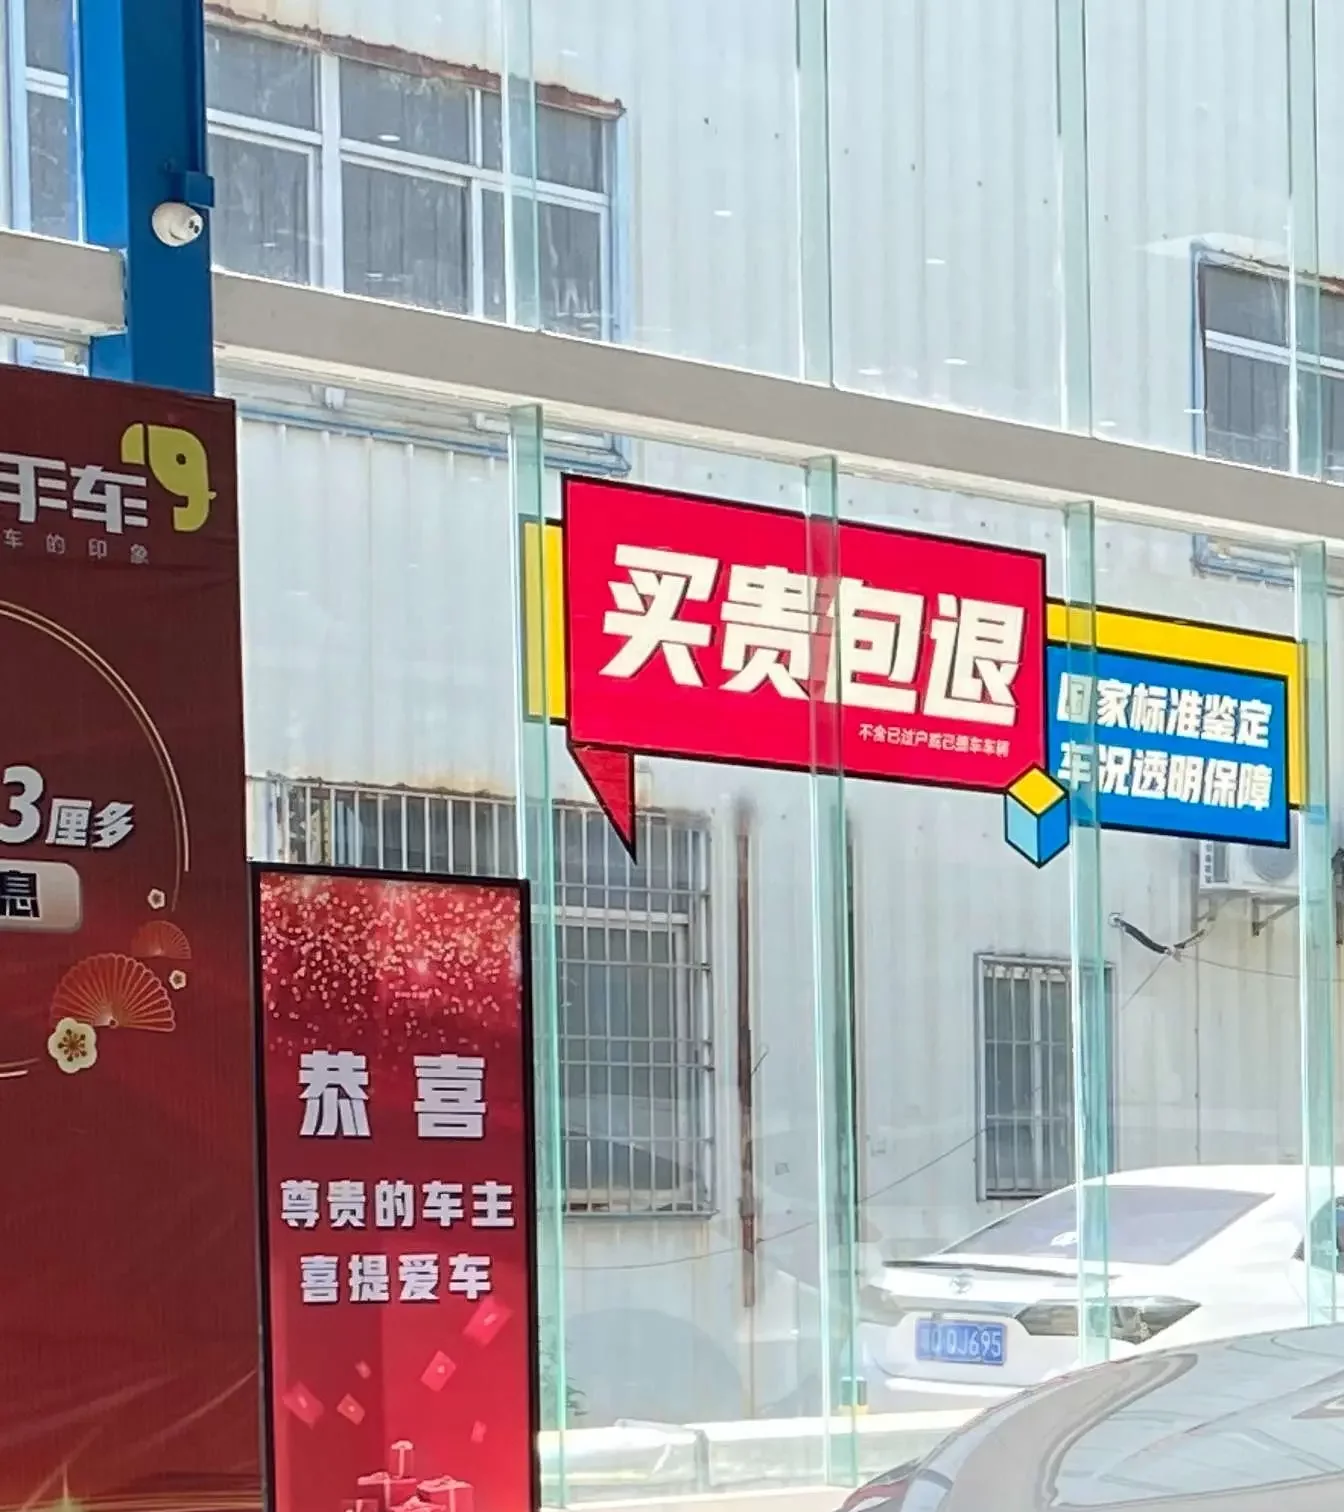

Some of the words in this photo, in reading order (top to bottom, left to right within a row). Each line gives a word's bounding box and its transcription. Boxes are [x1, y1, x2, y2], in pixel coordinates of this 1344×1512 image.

[0, 452, 148, 534] 手车
[600, 544, 1025, 726] 买贵包退
[1057, 672, 1272, 748] 国家标准鉴定
[0, 765, 134, 848] 3厘多
[1057, 740, 1273, 811] 车况透明保障
[298, 1050, 487, 1139] 恭喜
[281, 1179, 516, 1231] 尊贵的车主
[300, 1252, 492, 1304] 喜提爱车
